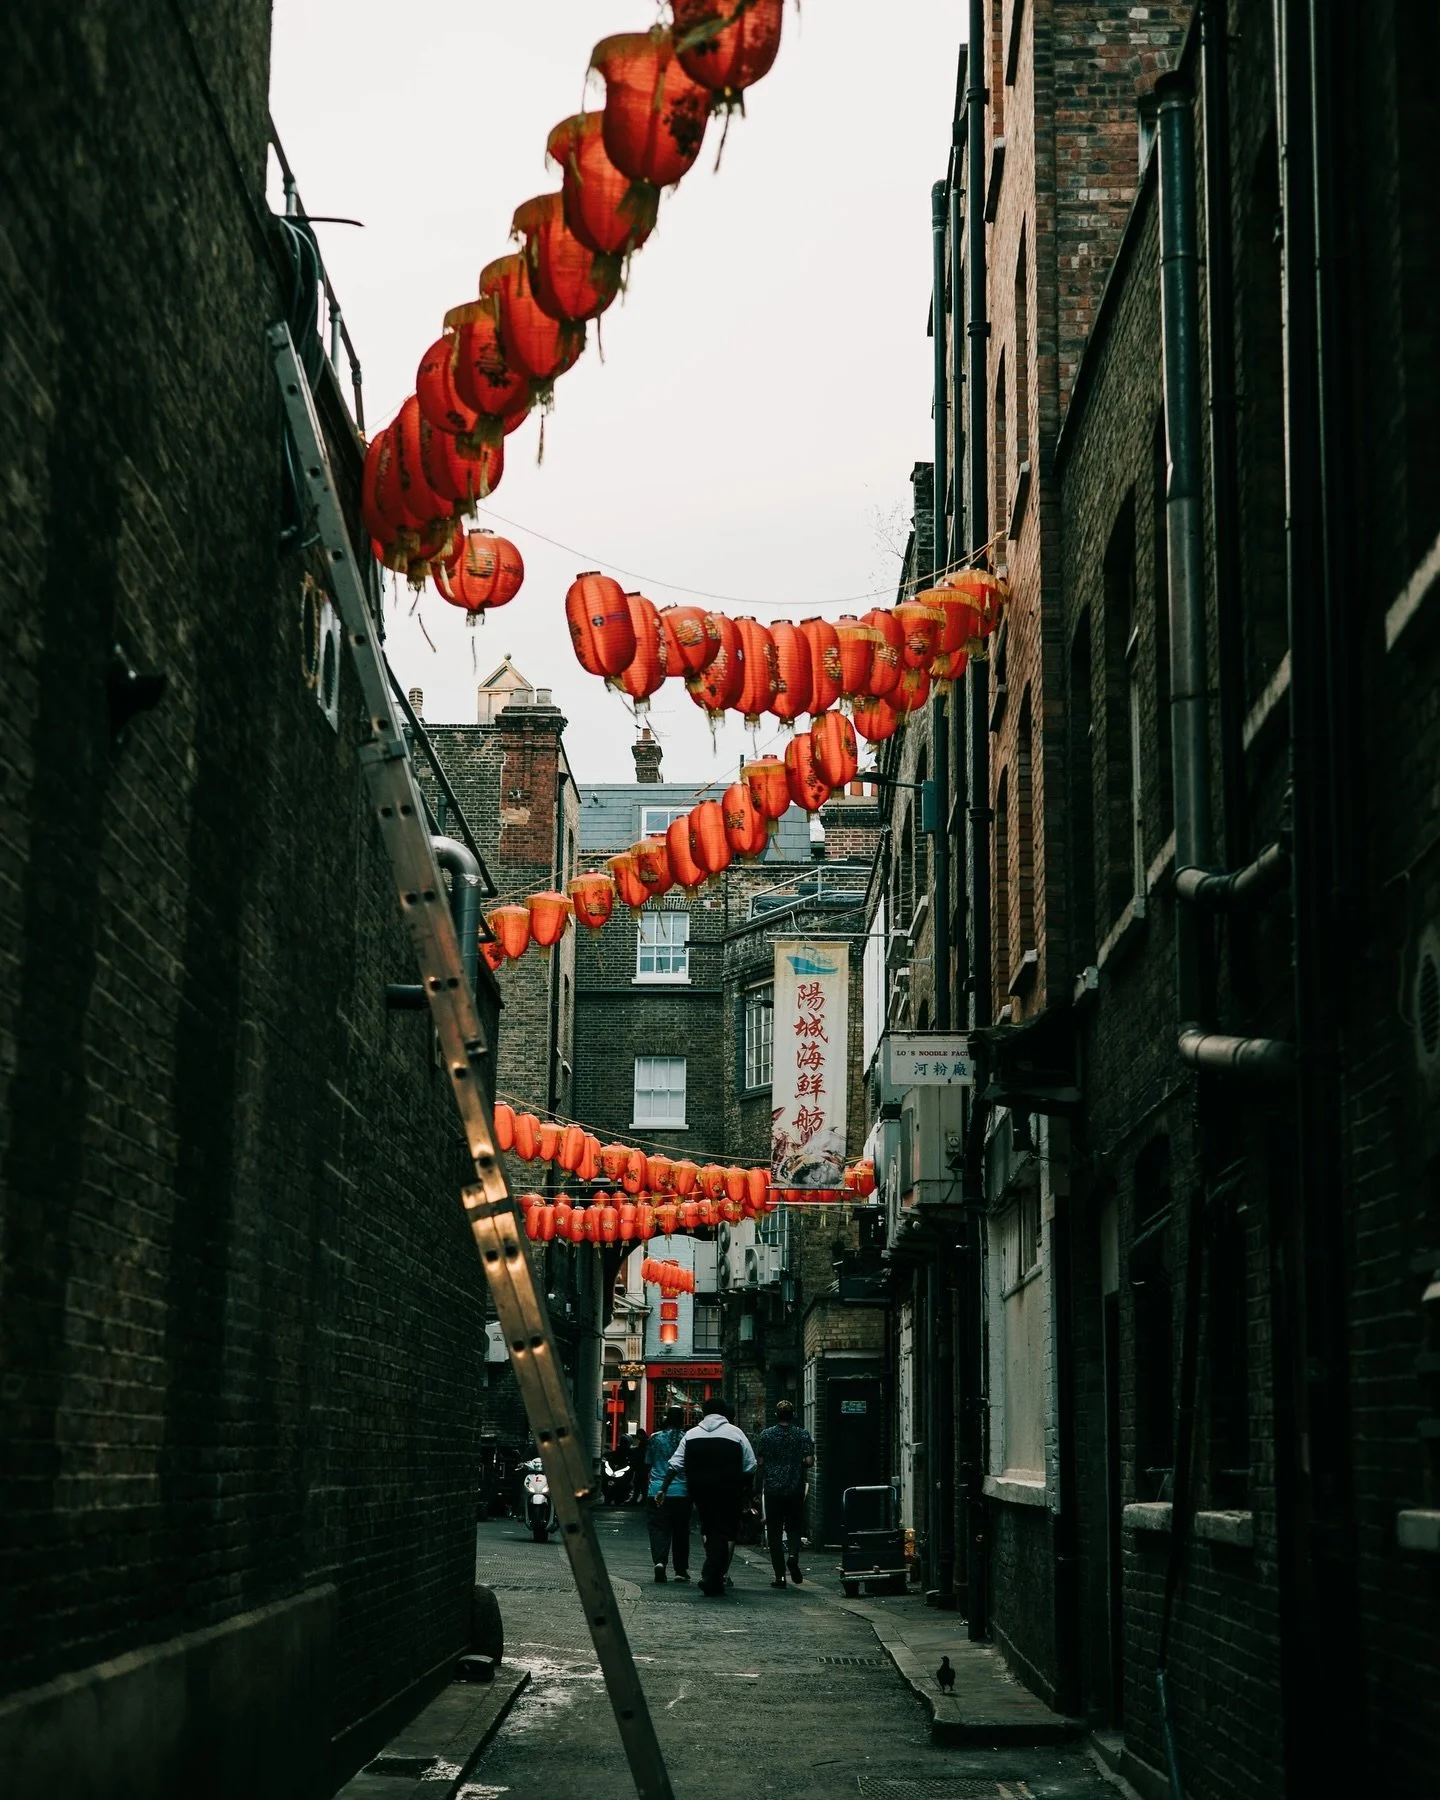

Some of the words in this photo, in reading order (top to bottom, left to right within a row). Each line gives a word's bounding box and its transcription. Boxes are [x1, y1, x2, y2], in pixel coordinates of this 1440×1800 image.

[792, 981, 829, 1133] 陽城海鮮舫
